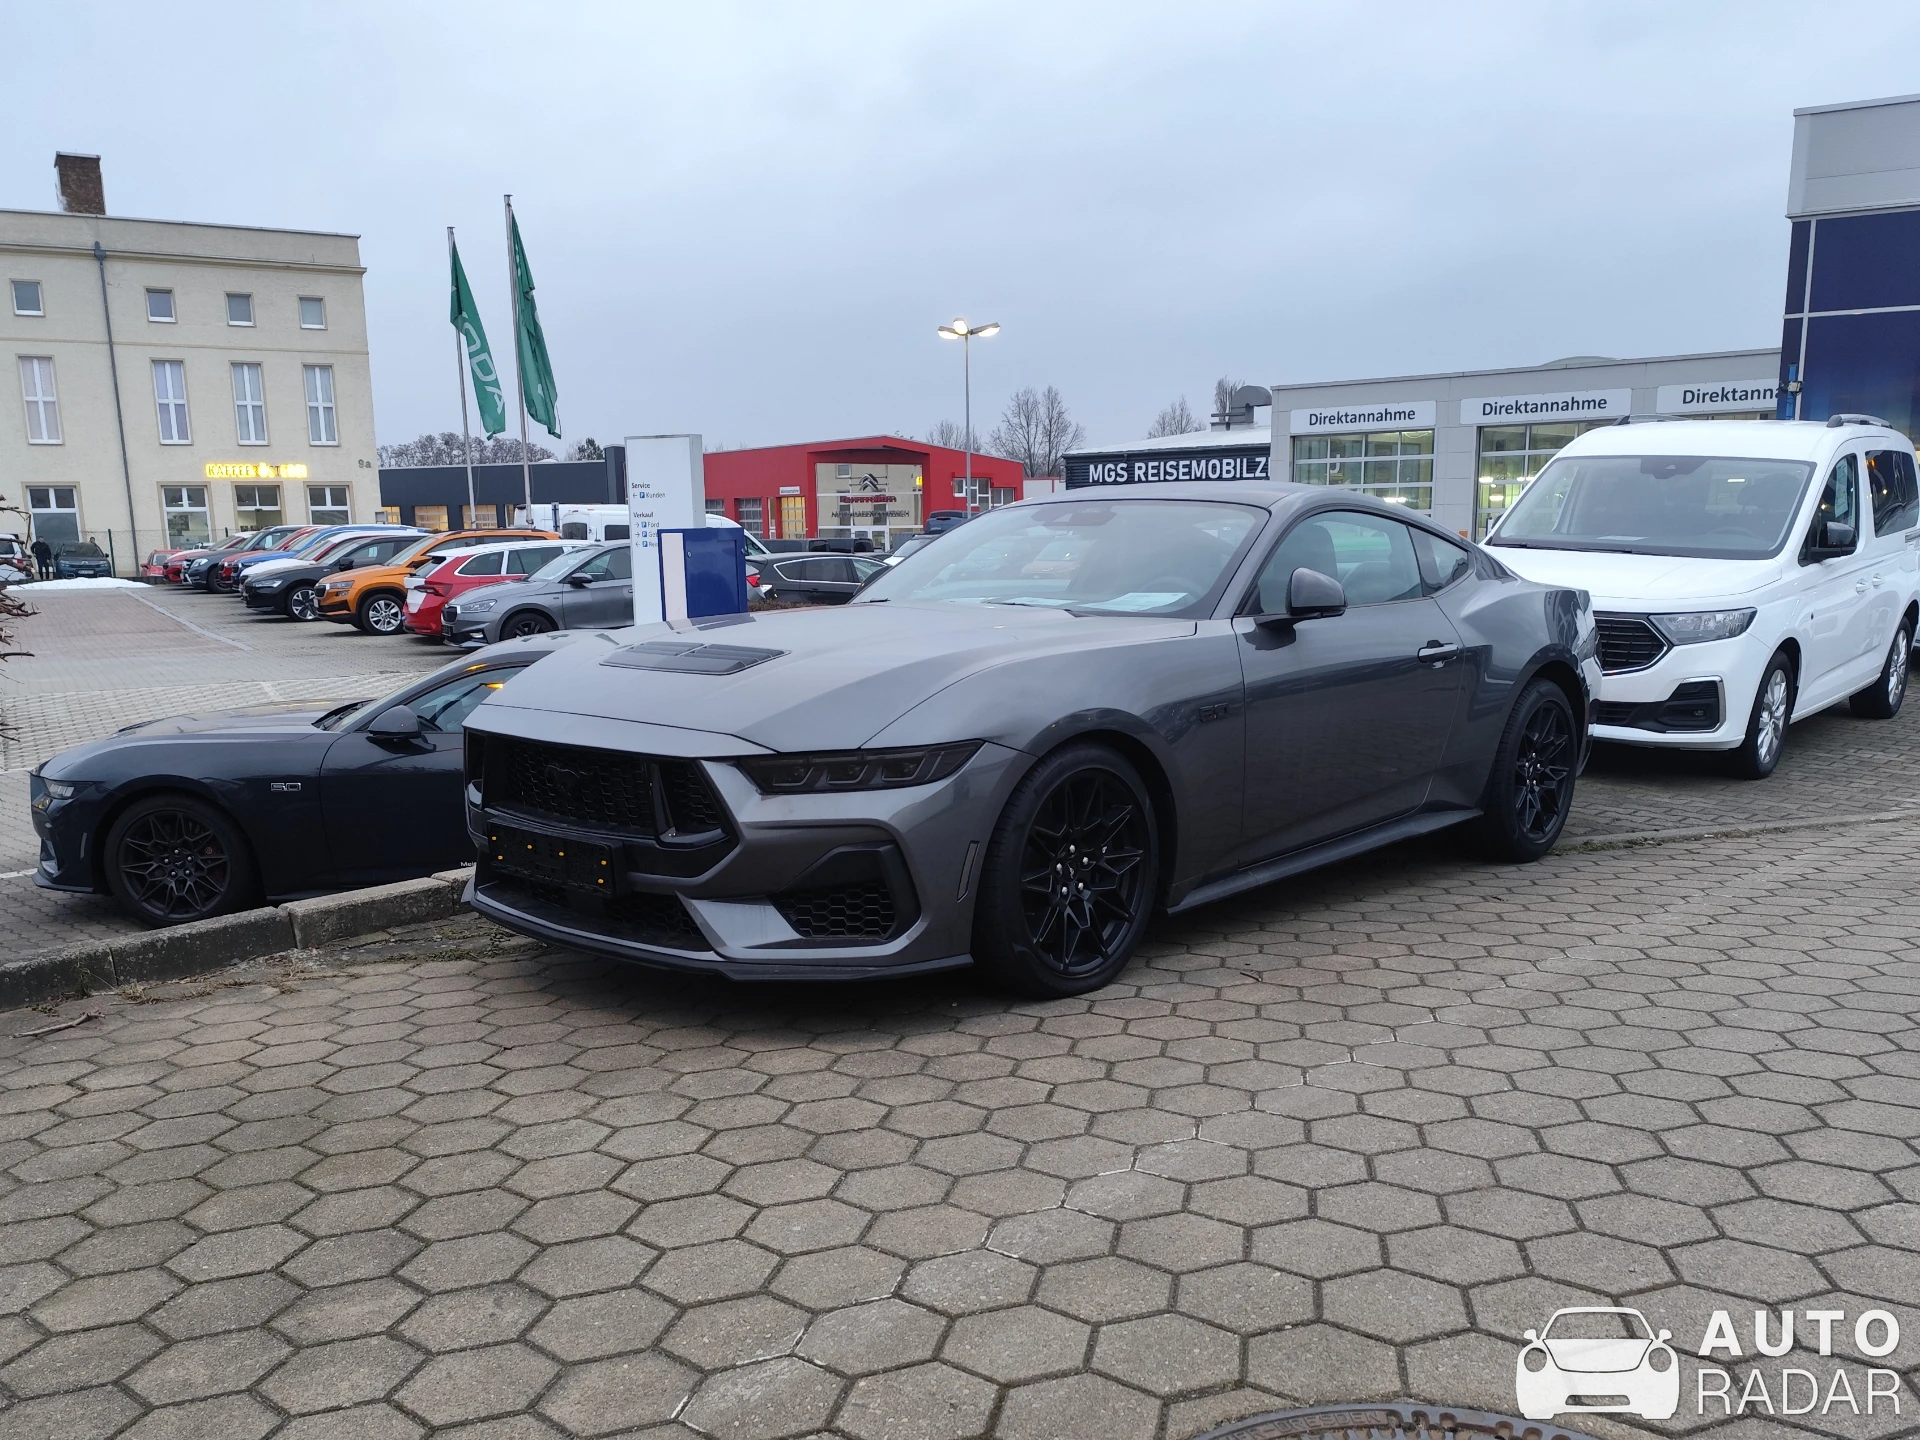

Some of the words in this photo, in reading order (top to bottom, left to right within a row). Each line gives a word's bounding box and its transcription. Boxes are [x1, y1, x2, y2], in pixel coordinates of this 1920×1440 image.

[1482, 396, 1608, 416] Direktannahme
[1308, 408, 1416, 426] Direktannahme
[358, 459, 372, 469] 9a
[1089, 463, 1128, 483] MGS
[1134, 456, 1271, 482] REISEMOBILZ
[271, 783, 301, 791] 5.0
